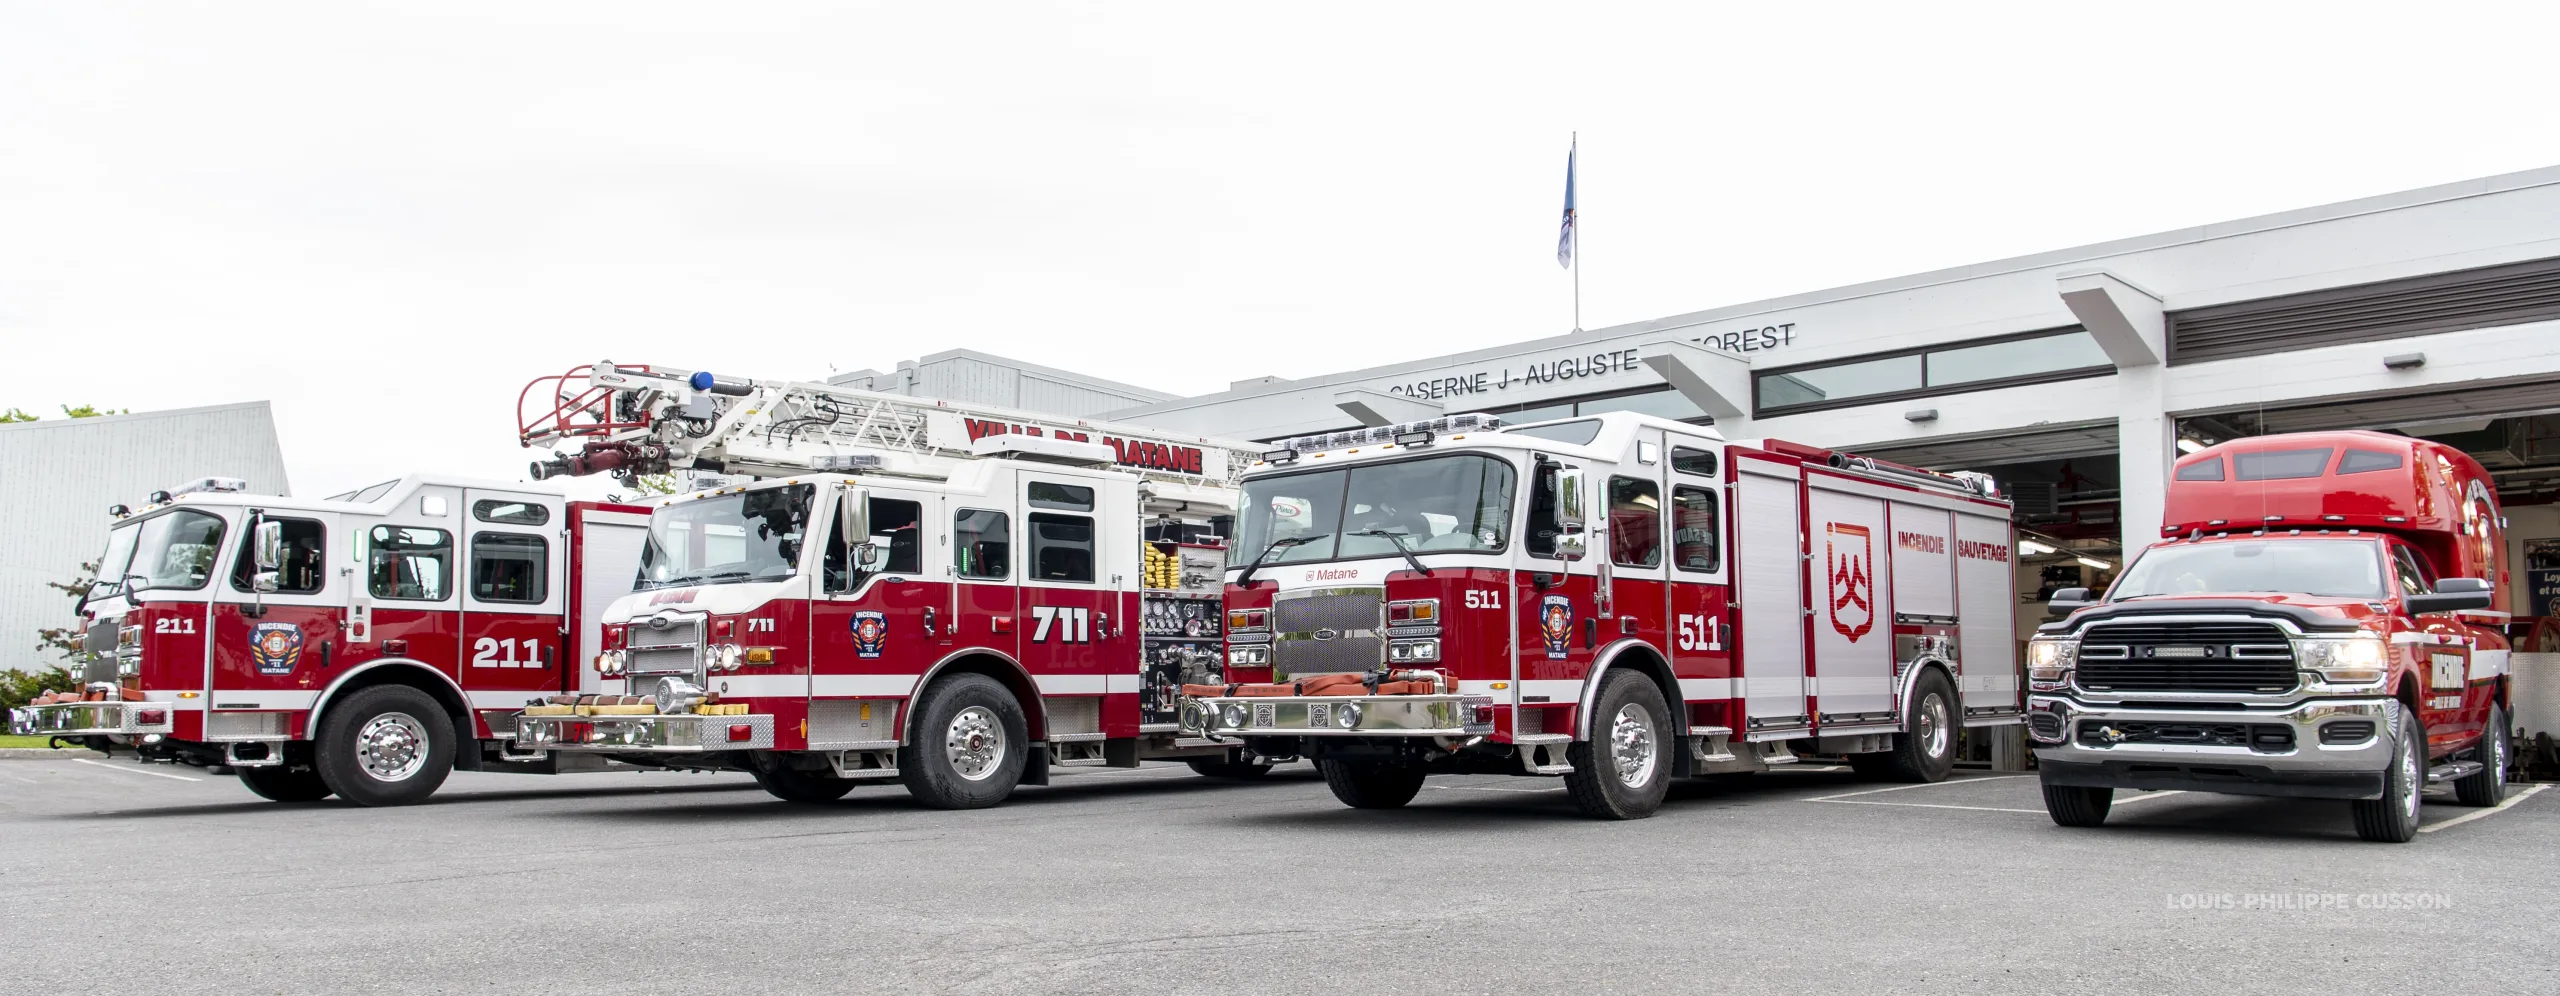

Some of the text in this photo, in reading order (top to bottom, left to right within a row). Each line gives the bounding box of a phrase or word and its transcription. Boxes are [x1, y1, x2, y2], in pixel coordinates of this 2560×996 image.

[1691, 323, 1796, 353] OREST
[1898, 531, 2008, 562] INCENDIE SAUVETAGE
[1317, 569, 1358, 580] Matane
[1465, 589, 1501, 609] 511
[1544, 595, 1569, 607] INCENDIE
[855, 611, 884, 619] INCENDIE
[155, 618, 196, 634] 211
[257, 622, 297, 632] INCENDIE
[748, 618, 775, 632] 711
[1032, 606, 1089, 644] 711
[1678, 613, 1721, 650] 511
[472, 637, 543, 669] 211
